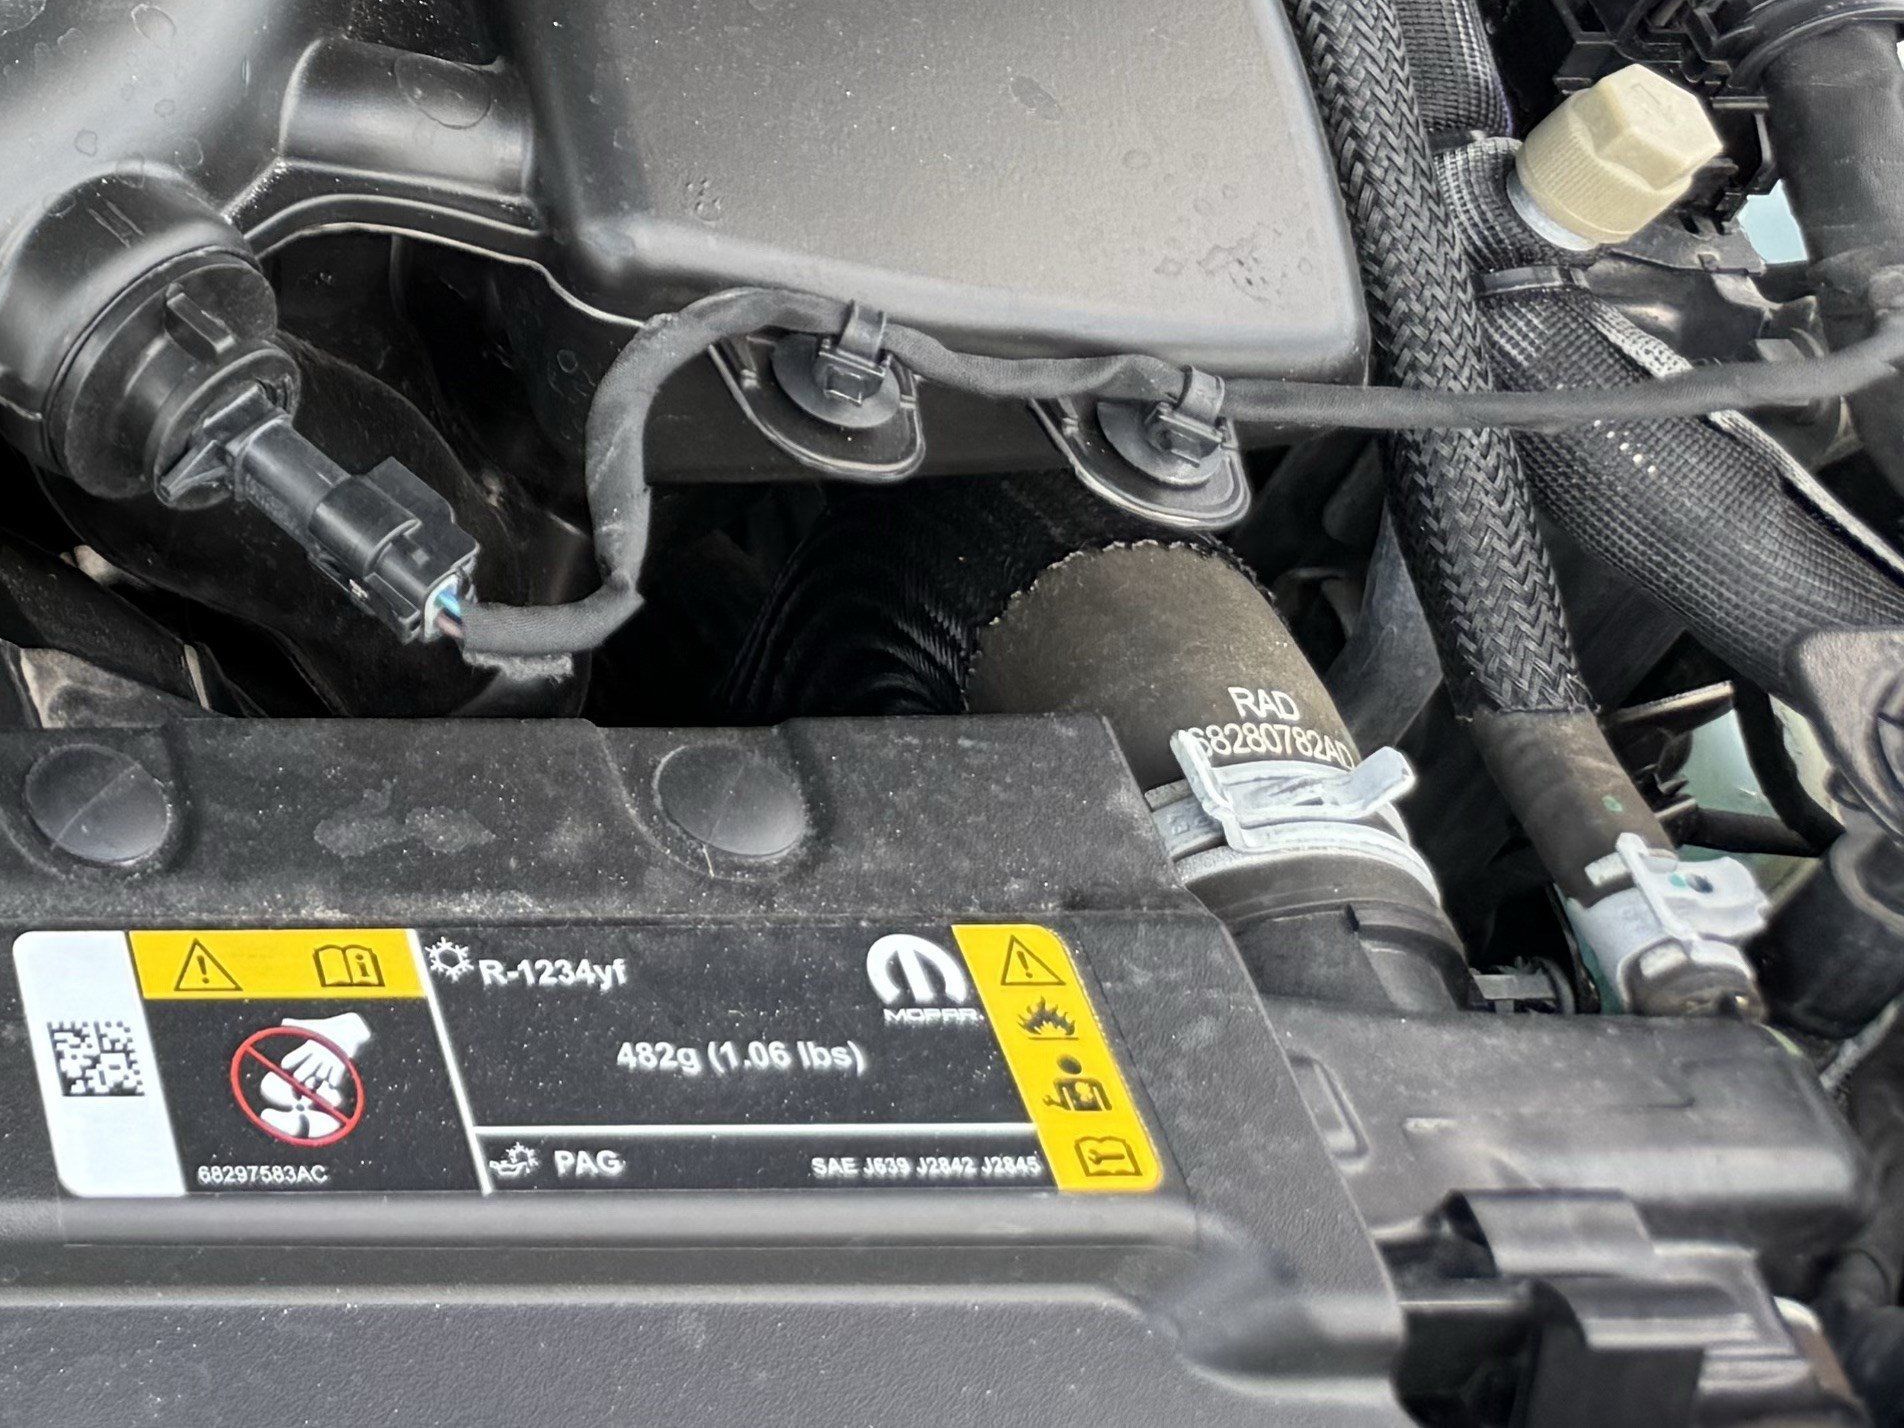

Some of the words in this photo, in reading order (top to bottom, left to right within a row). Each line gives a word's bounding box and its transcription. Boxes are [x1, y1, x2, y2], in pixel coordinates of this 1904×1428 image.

[1227, 686, 1301, 721] RAD
[478, 957, 628, 992] R-1234yf
[883, 1007, 980, 1026] MOPAR
[617, 1041, 702, 1075] 482g
[707, 1040, 792, 1077] (1.06
[797, 1040, 867, 1077] lbs)
[197, 1165, 329, 1185] 68297583AC
[554, 1148, 626, 1178] PAG
[811, 1156, 859, 1178] SAE
[863, 1156, 910, 1178] J639
[915, 1156, 976, 1178] J2842
[980, 1155, 1042, 1178] J2845
